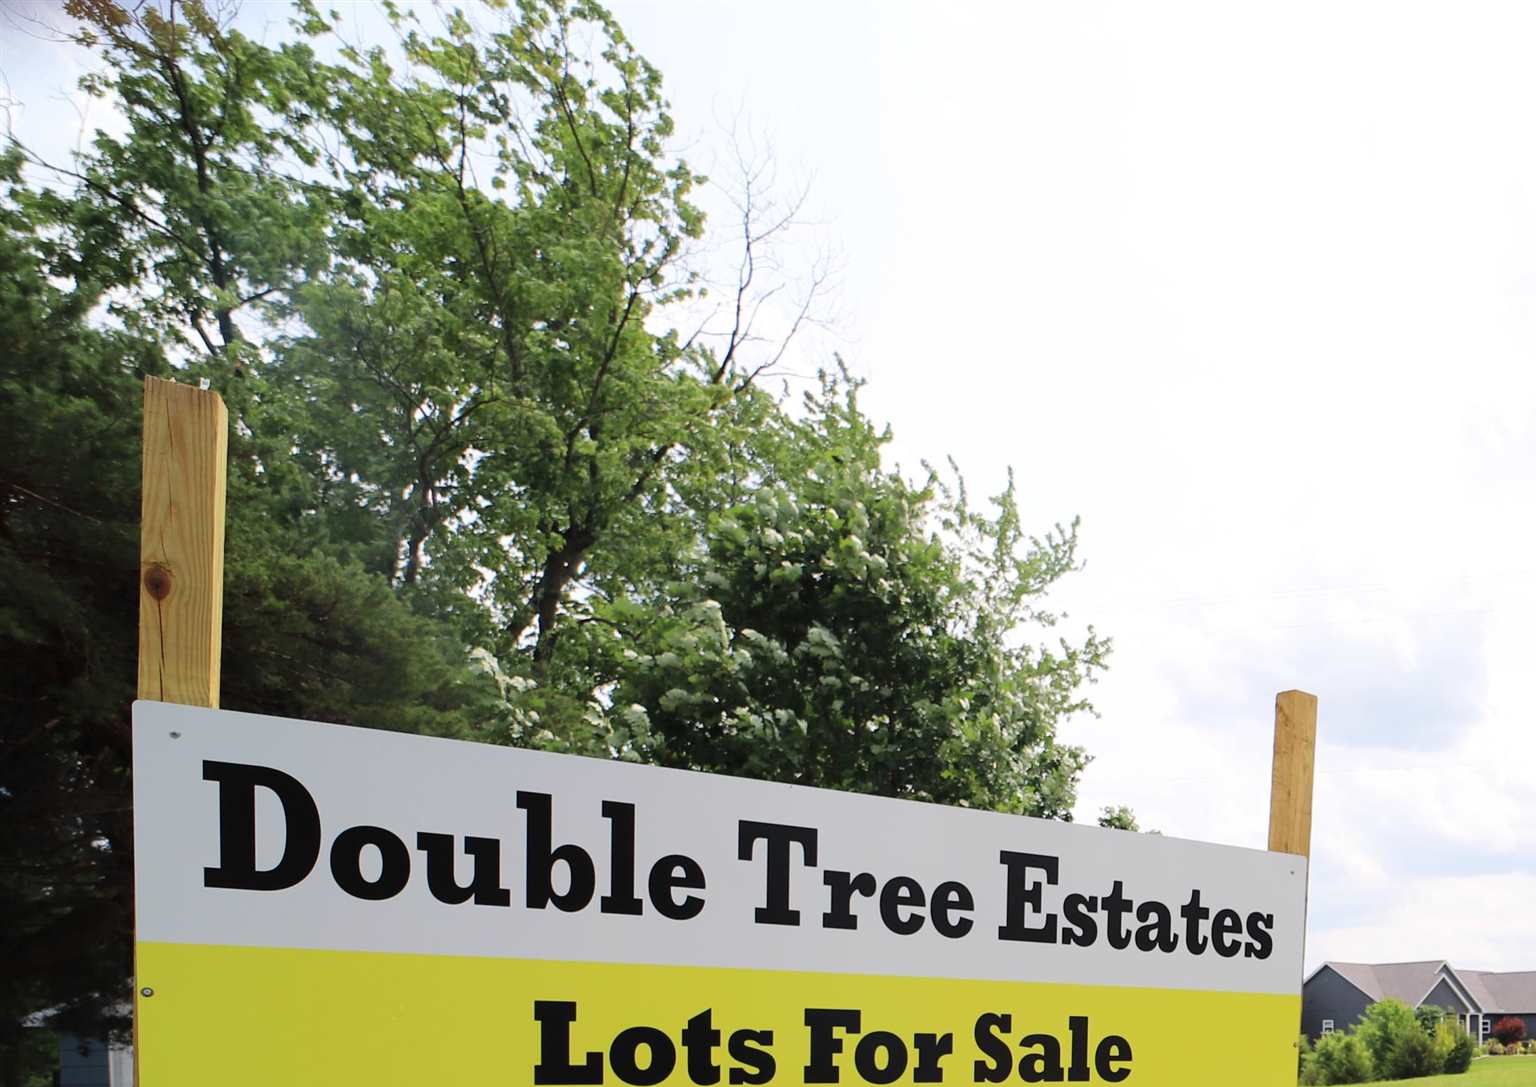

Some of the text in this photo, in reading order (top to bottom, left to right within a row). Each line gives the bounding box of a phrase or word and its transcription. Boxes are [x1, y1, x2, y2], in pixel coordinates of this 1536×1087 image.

[202, 759, 1274, 960] Double Tree Estates
[534, 1000, 1133, 1087] Lots For Sale
